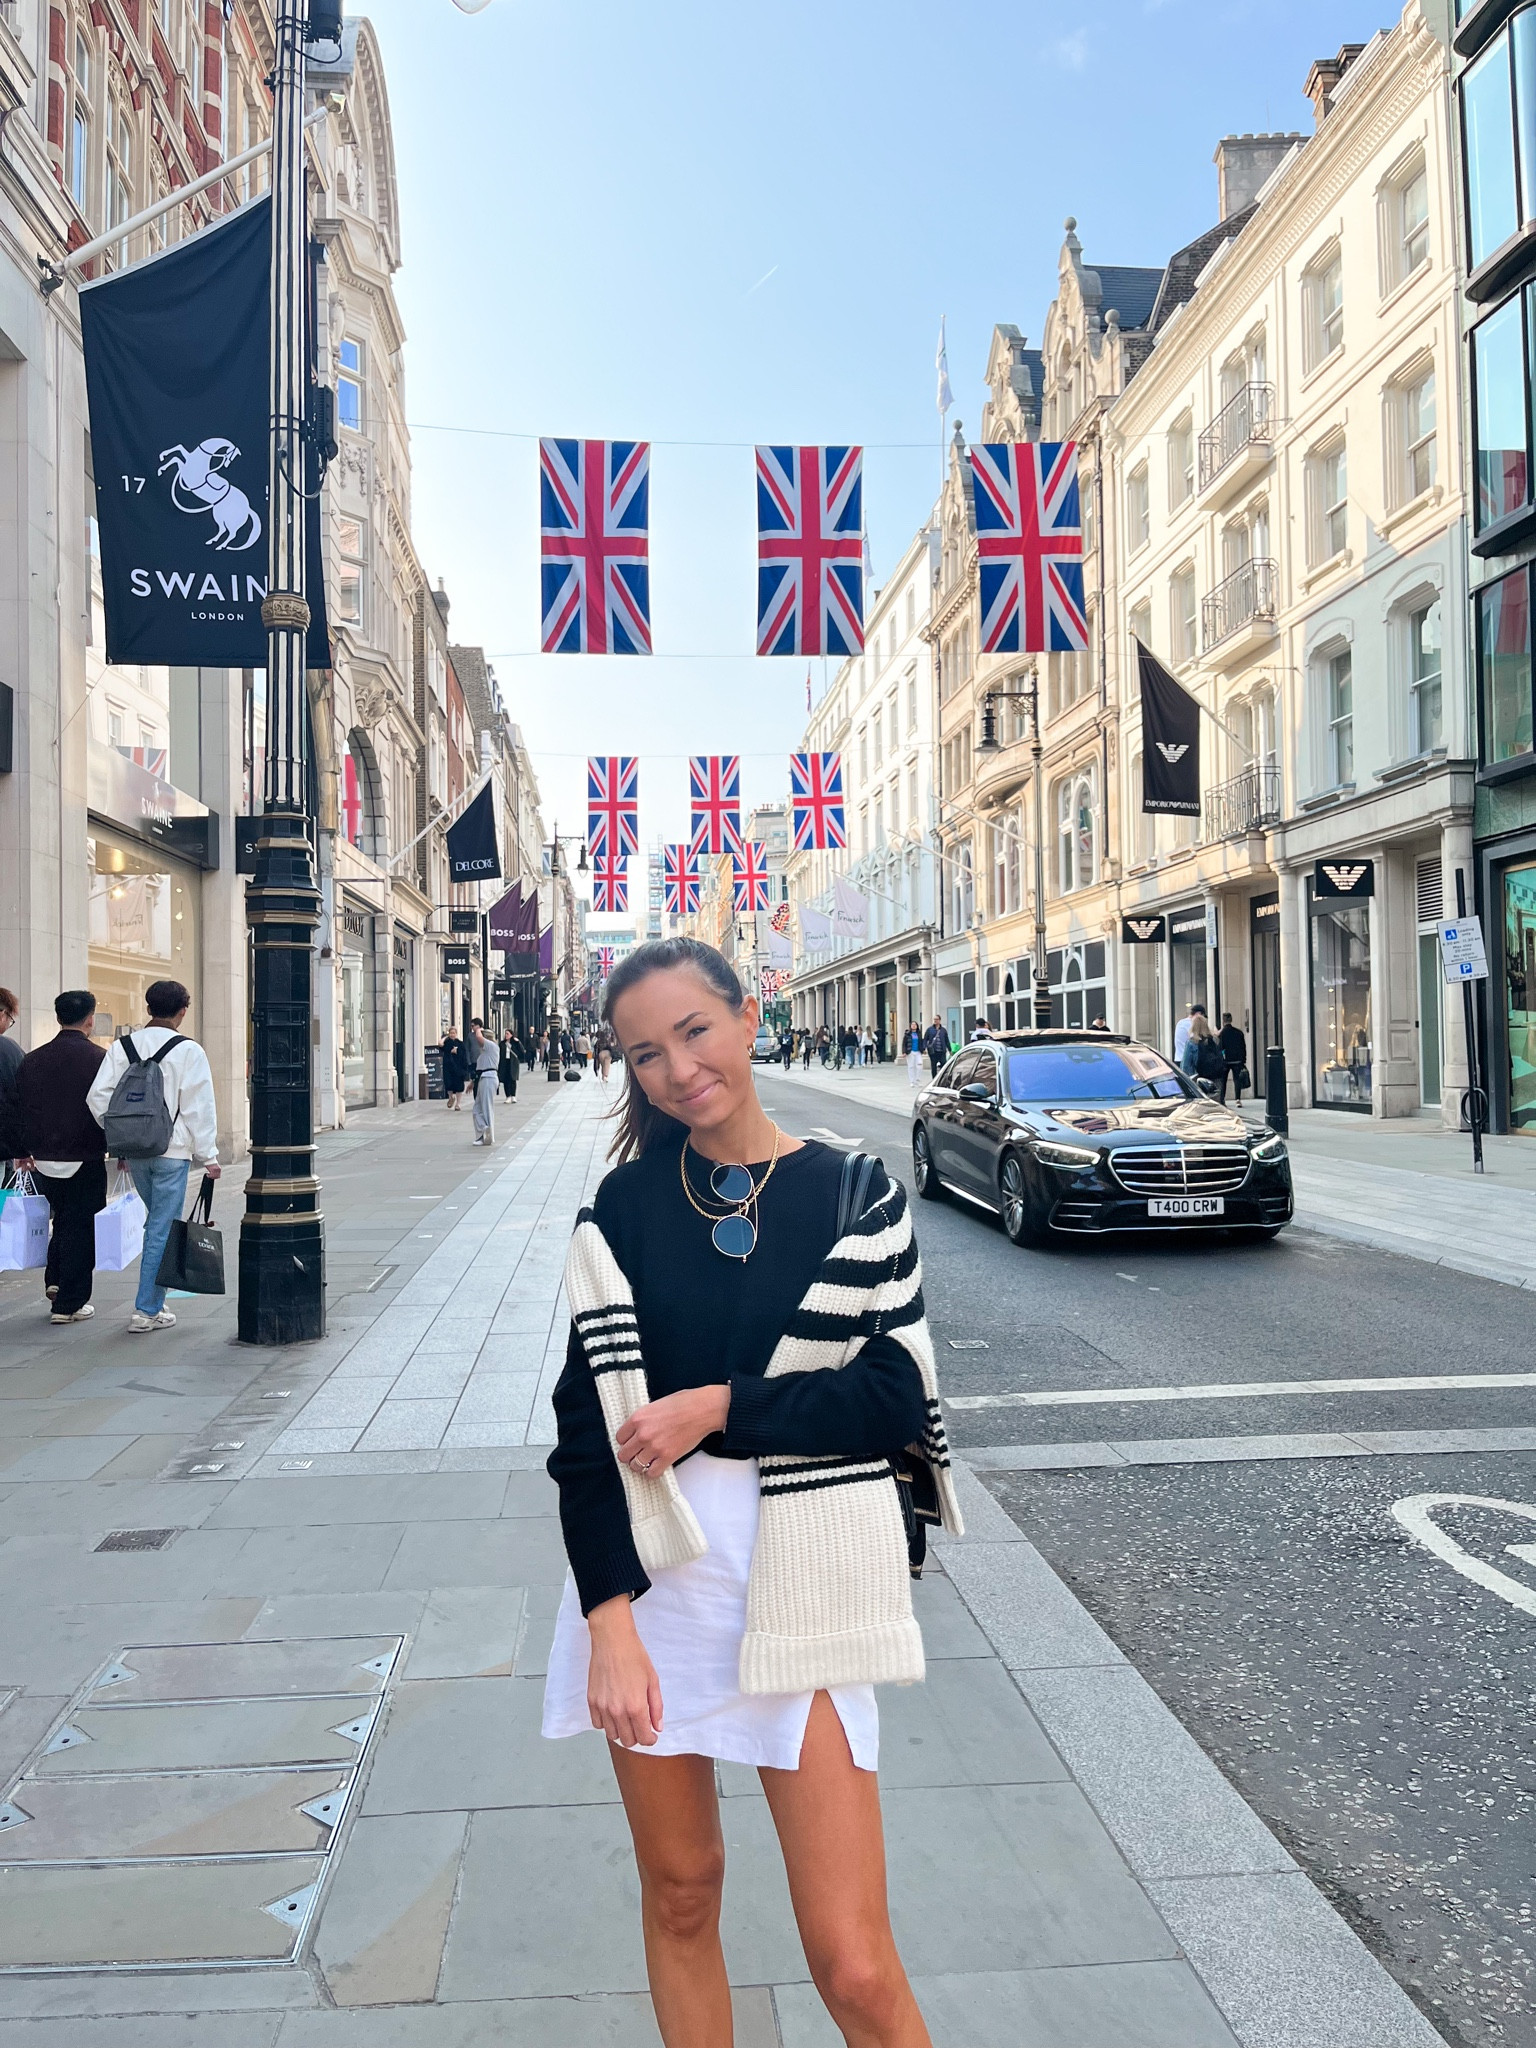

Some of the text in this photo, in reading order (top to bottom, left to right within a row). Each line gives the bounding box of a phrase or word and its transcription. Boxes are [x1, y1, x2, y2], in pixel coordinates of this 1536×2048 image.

[121, 475, 146, 494] 17
[130, 568, 268, 602] SWAIN
[191, 612, 244, 621] LONDON
[141, 797, 173, 829] SWAINE
[490, 929, 515, 937] BOSS
[1464, 964, 1471, 973] P
[1154, 1199, 1218, 1213] T400 CRW
